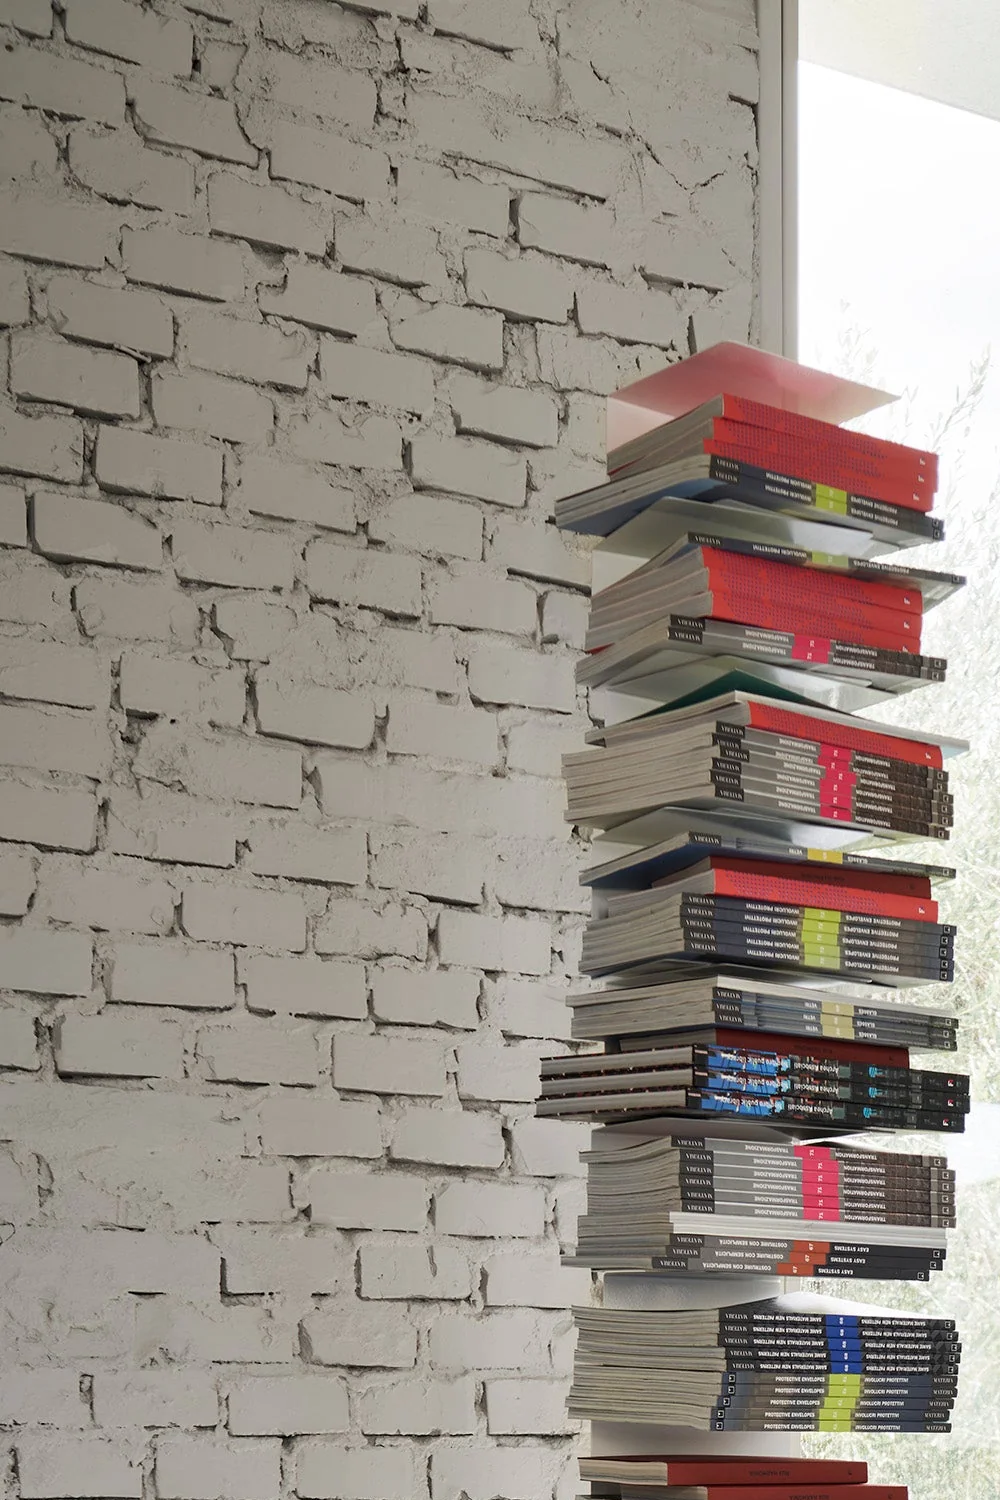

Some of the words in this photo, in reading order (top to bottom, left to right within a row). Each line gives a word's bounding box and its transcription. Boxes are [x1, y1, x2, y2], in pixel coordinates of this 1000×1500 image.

[771, 929, 796, 937] INVOLUCRI
[842, 937, 868, 946] ENVELOPES
[869, 940, 897, 949] PROTECTIVE
[845, 961, 871, 969] ENVELOPES
[871, 964, 899, 972] PROTECTIVE
[745, 1145, 789, 1153] TRASFORMAZIONE
[835, 1152, 877, 1160] TRANSFORMATION
[753, 1183, 797, 1191] TRASFORMAZIONE
[843, 1189, 885, 1197] TRANSFORMATION
[744, 1263, 771, 1271] COSTRUIRE
